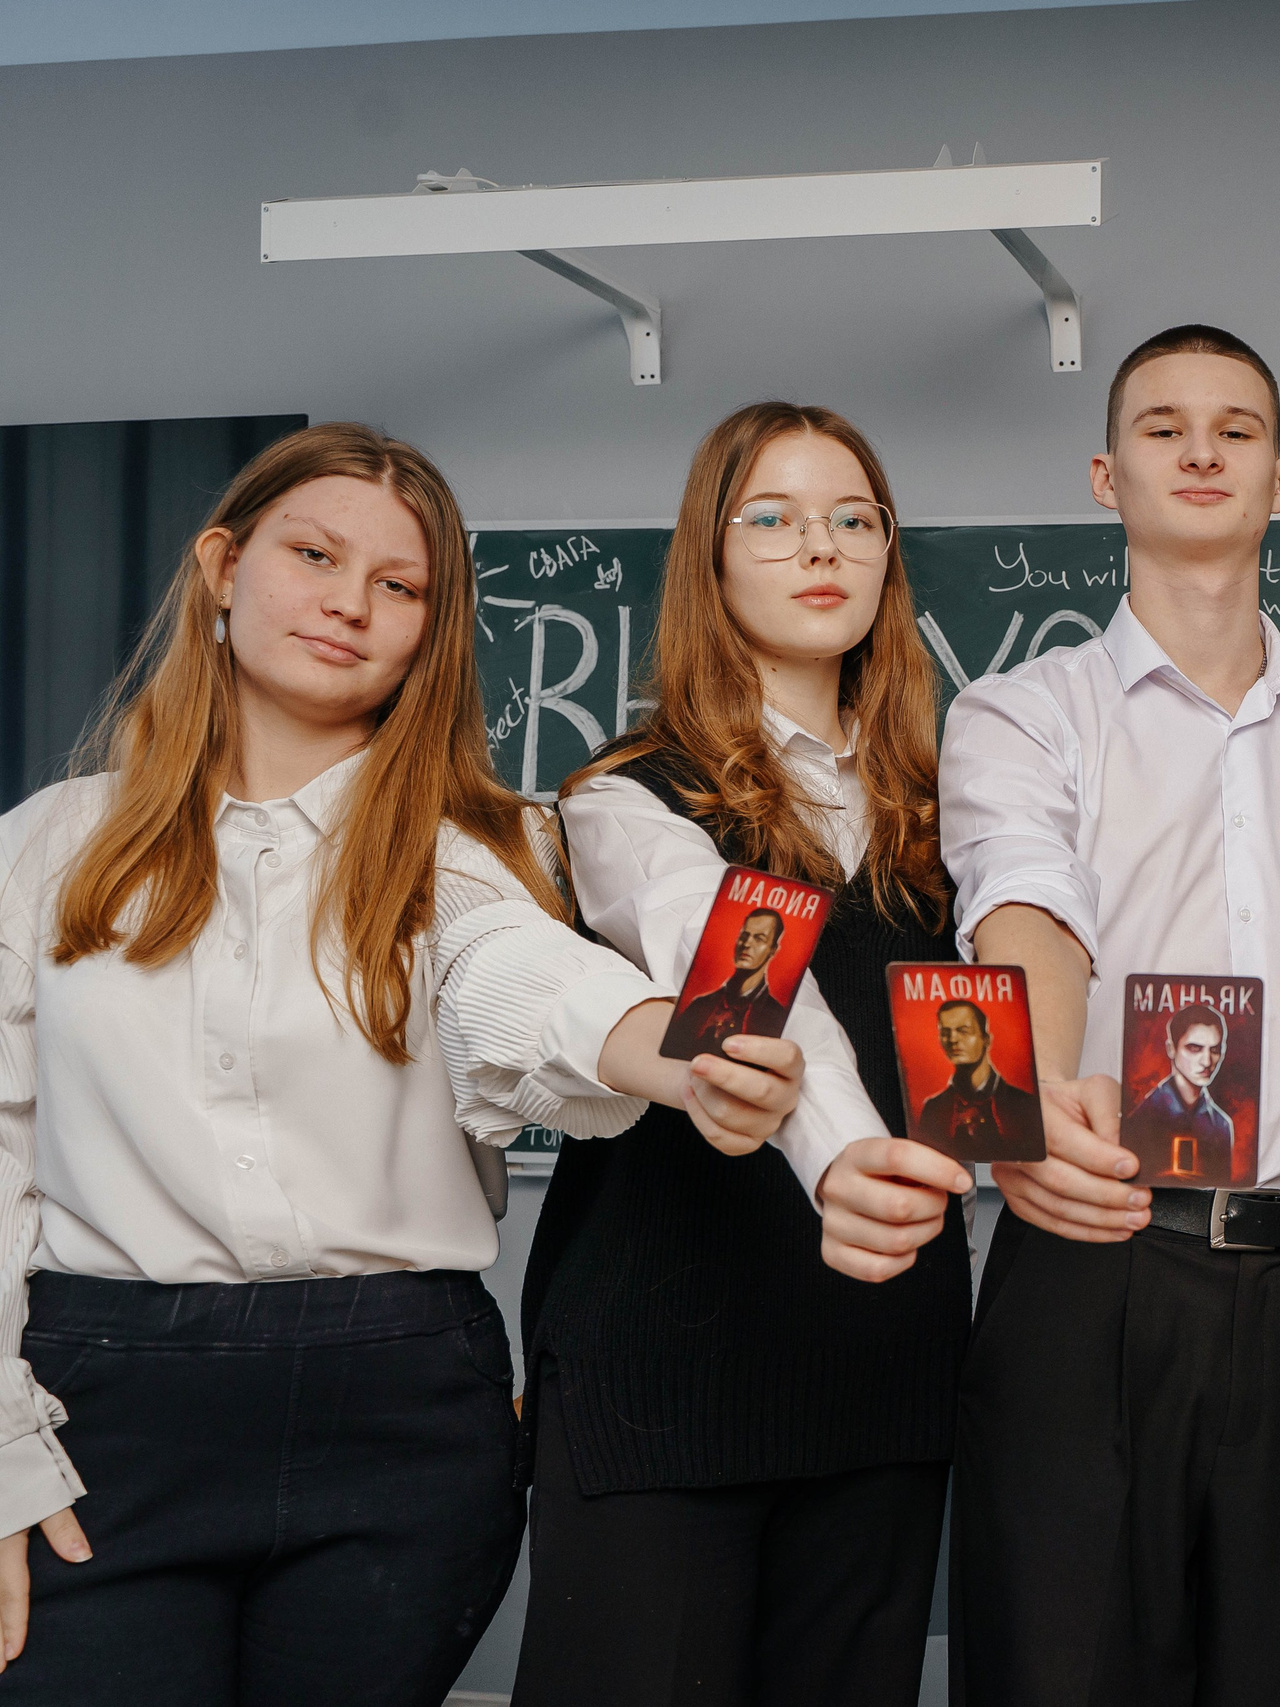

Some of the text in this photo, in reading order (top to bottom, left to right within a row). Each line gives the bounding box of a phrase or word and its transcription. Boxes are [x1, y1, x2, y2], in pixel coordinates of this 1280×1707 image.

[989, 542, 1070, 592] You
[1083, 543, 1129, 587] wil
[728, 874, 821, 920] МАФИЯ
[903, 972, 1013, 1002] МАФИЯ
[1133, 982, 1255, 1015] МАНЬЯК
